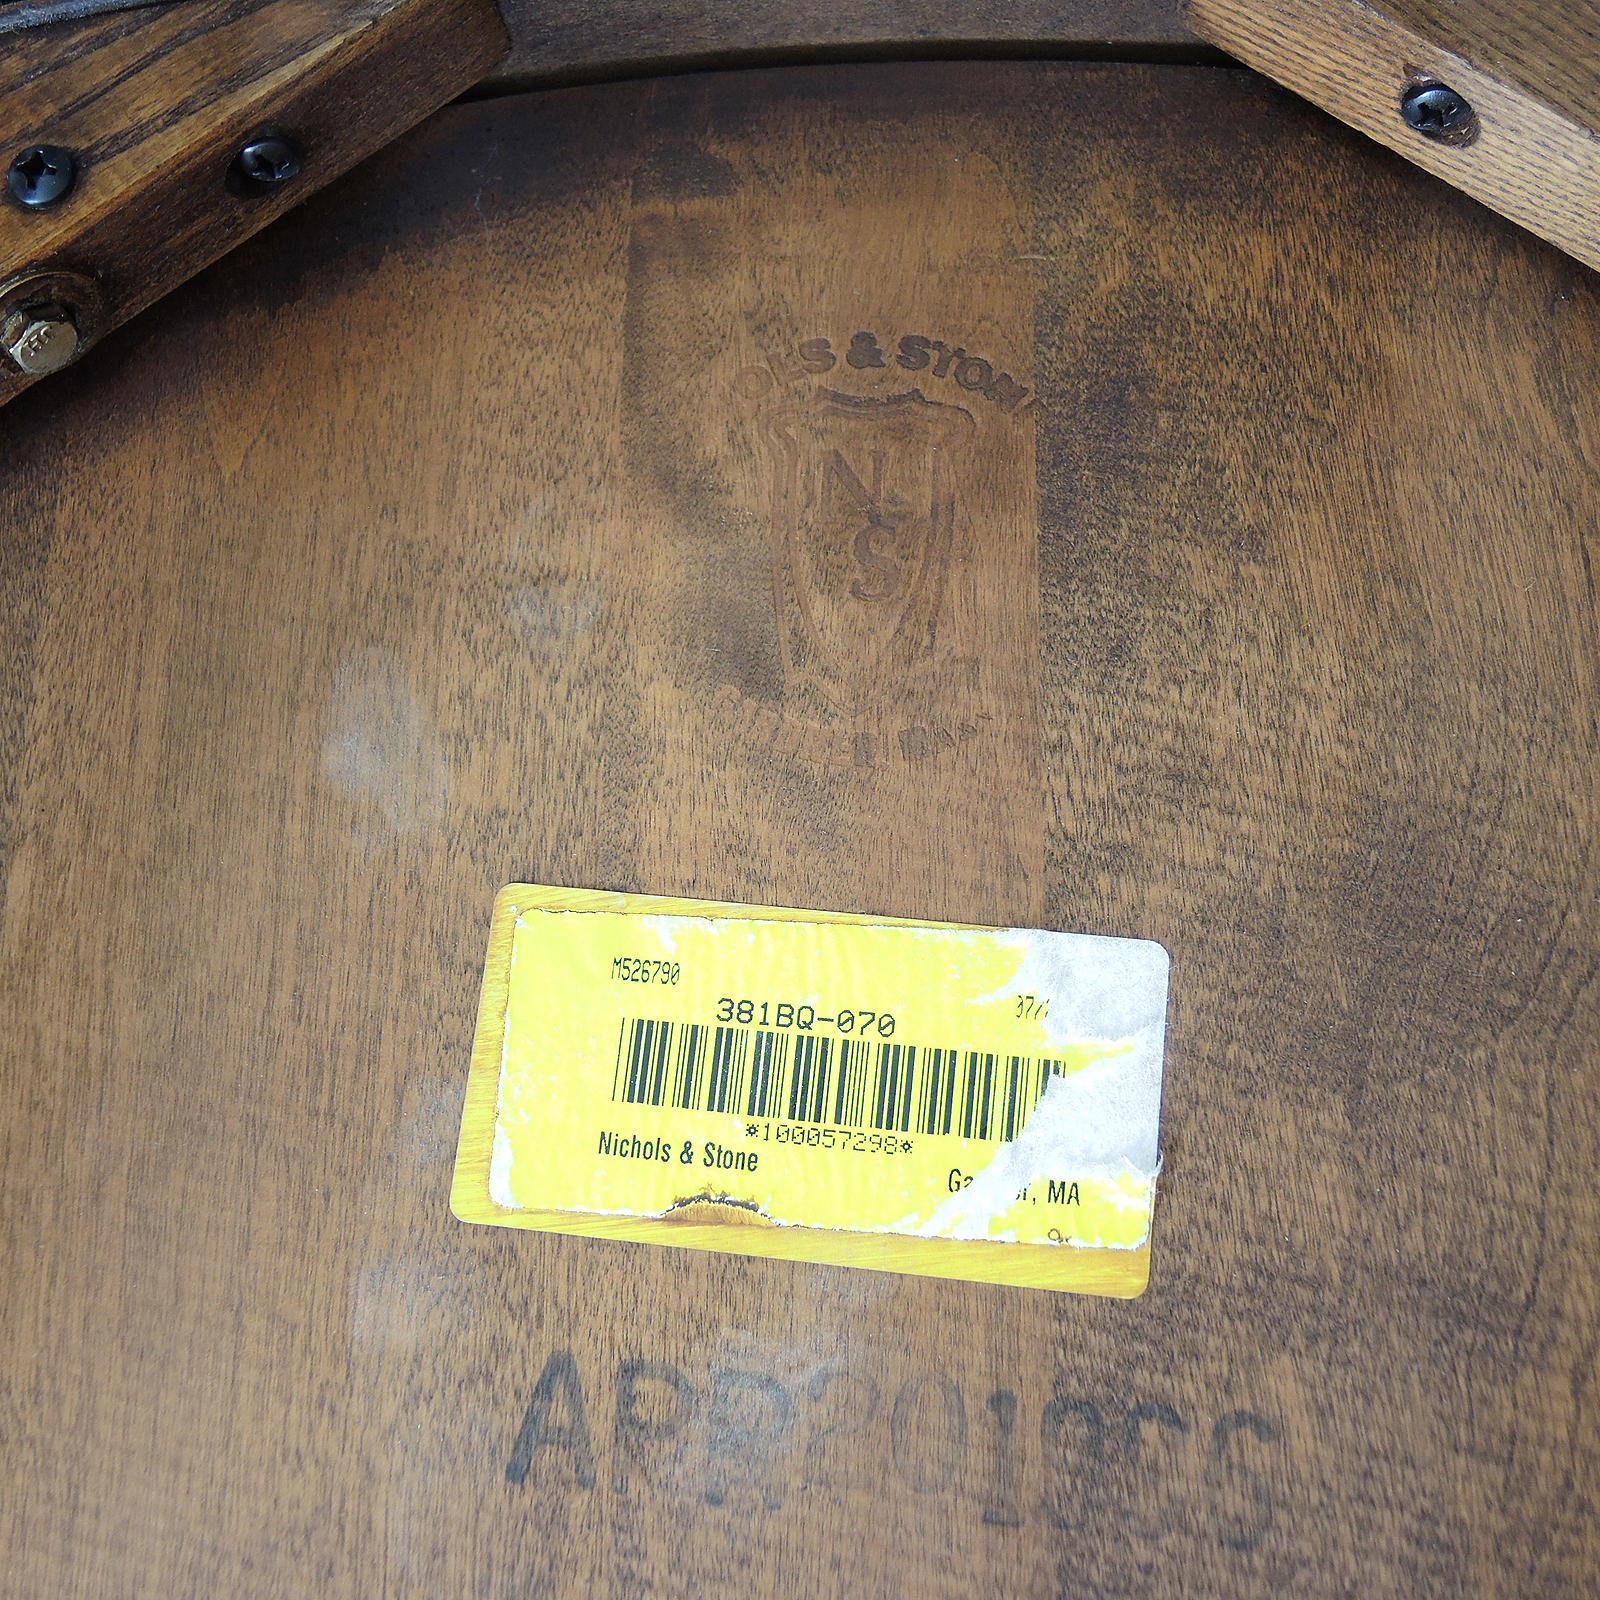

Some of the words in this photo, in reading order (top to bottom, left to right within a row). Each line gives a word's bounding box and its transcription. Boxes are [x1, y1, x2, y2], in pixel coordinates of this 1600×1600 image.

[846, 331, 886, 369] &
[611, 957, 681, 986] M526790
[716, 998, 896, 1038] 381BQ-070
[598, 1131, 672, 1163] Nichols
[679, 1140, 694, 1164] &
[703, 1142, 759, 1172] Stone
[1048, 1179, 1081, 1207] MA
